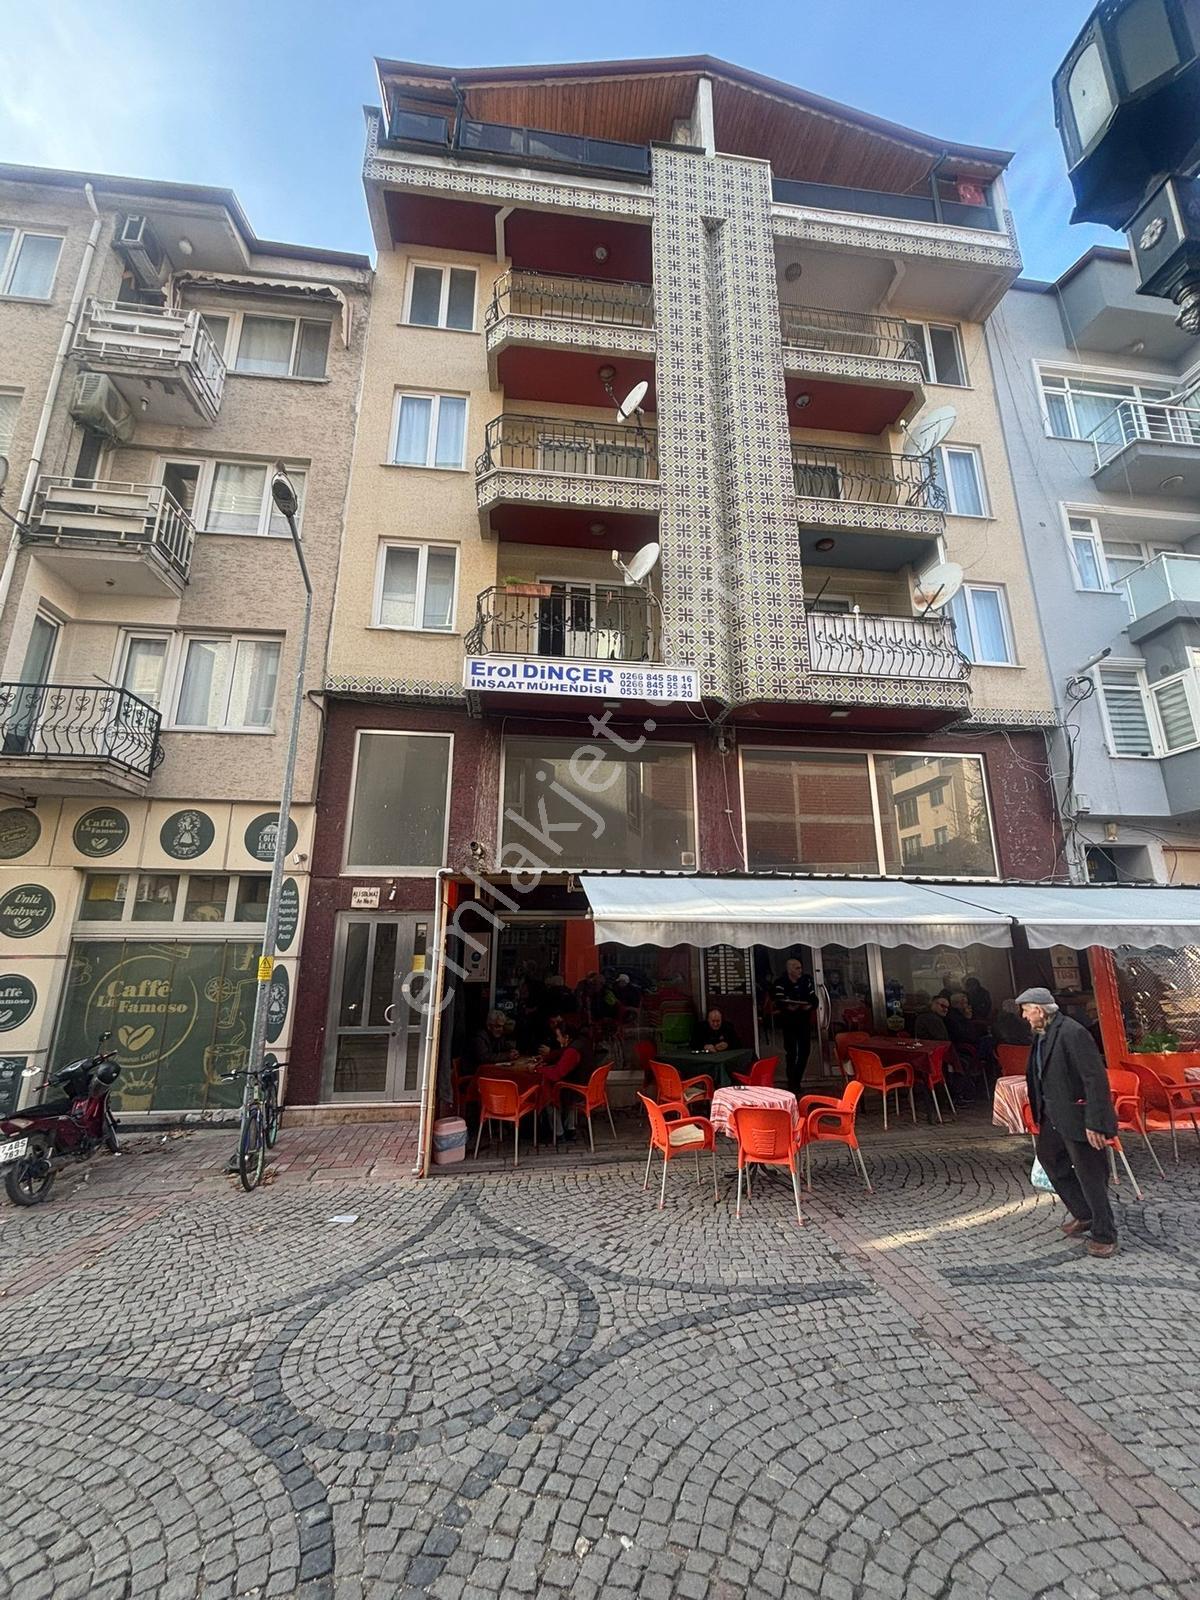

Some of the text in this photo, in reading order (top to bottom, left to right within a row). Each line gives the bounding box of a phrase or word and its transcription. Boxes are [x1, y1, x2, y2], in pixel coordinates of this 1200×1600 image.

[471, 661, 517, 678] Erol
[620, 672, 693, 683] 0266 845 58 16
[472, 677, 607, 694] İNŞAAT MÜHENDİSİ
[620, 680, 643, 688] 0266
[646, 681, 664, 689] 845
[620, 687, 643, 696] 0533
[646, 688, 663, 696] 281
[681, 690, 693, 698] 20
[14, 891, 42, 904] Ünlü
[3, 906, 47, 917] Kahveci
[118, 1000, 188, 1013] Famoso
